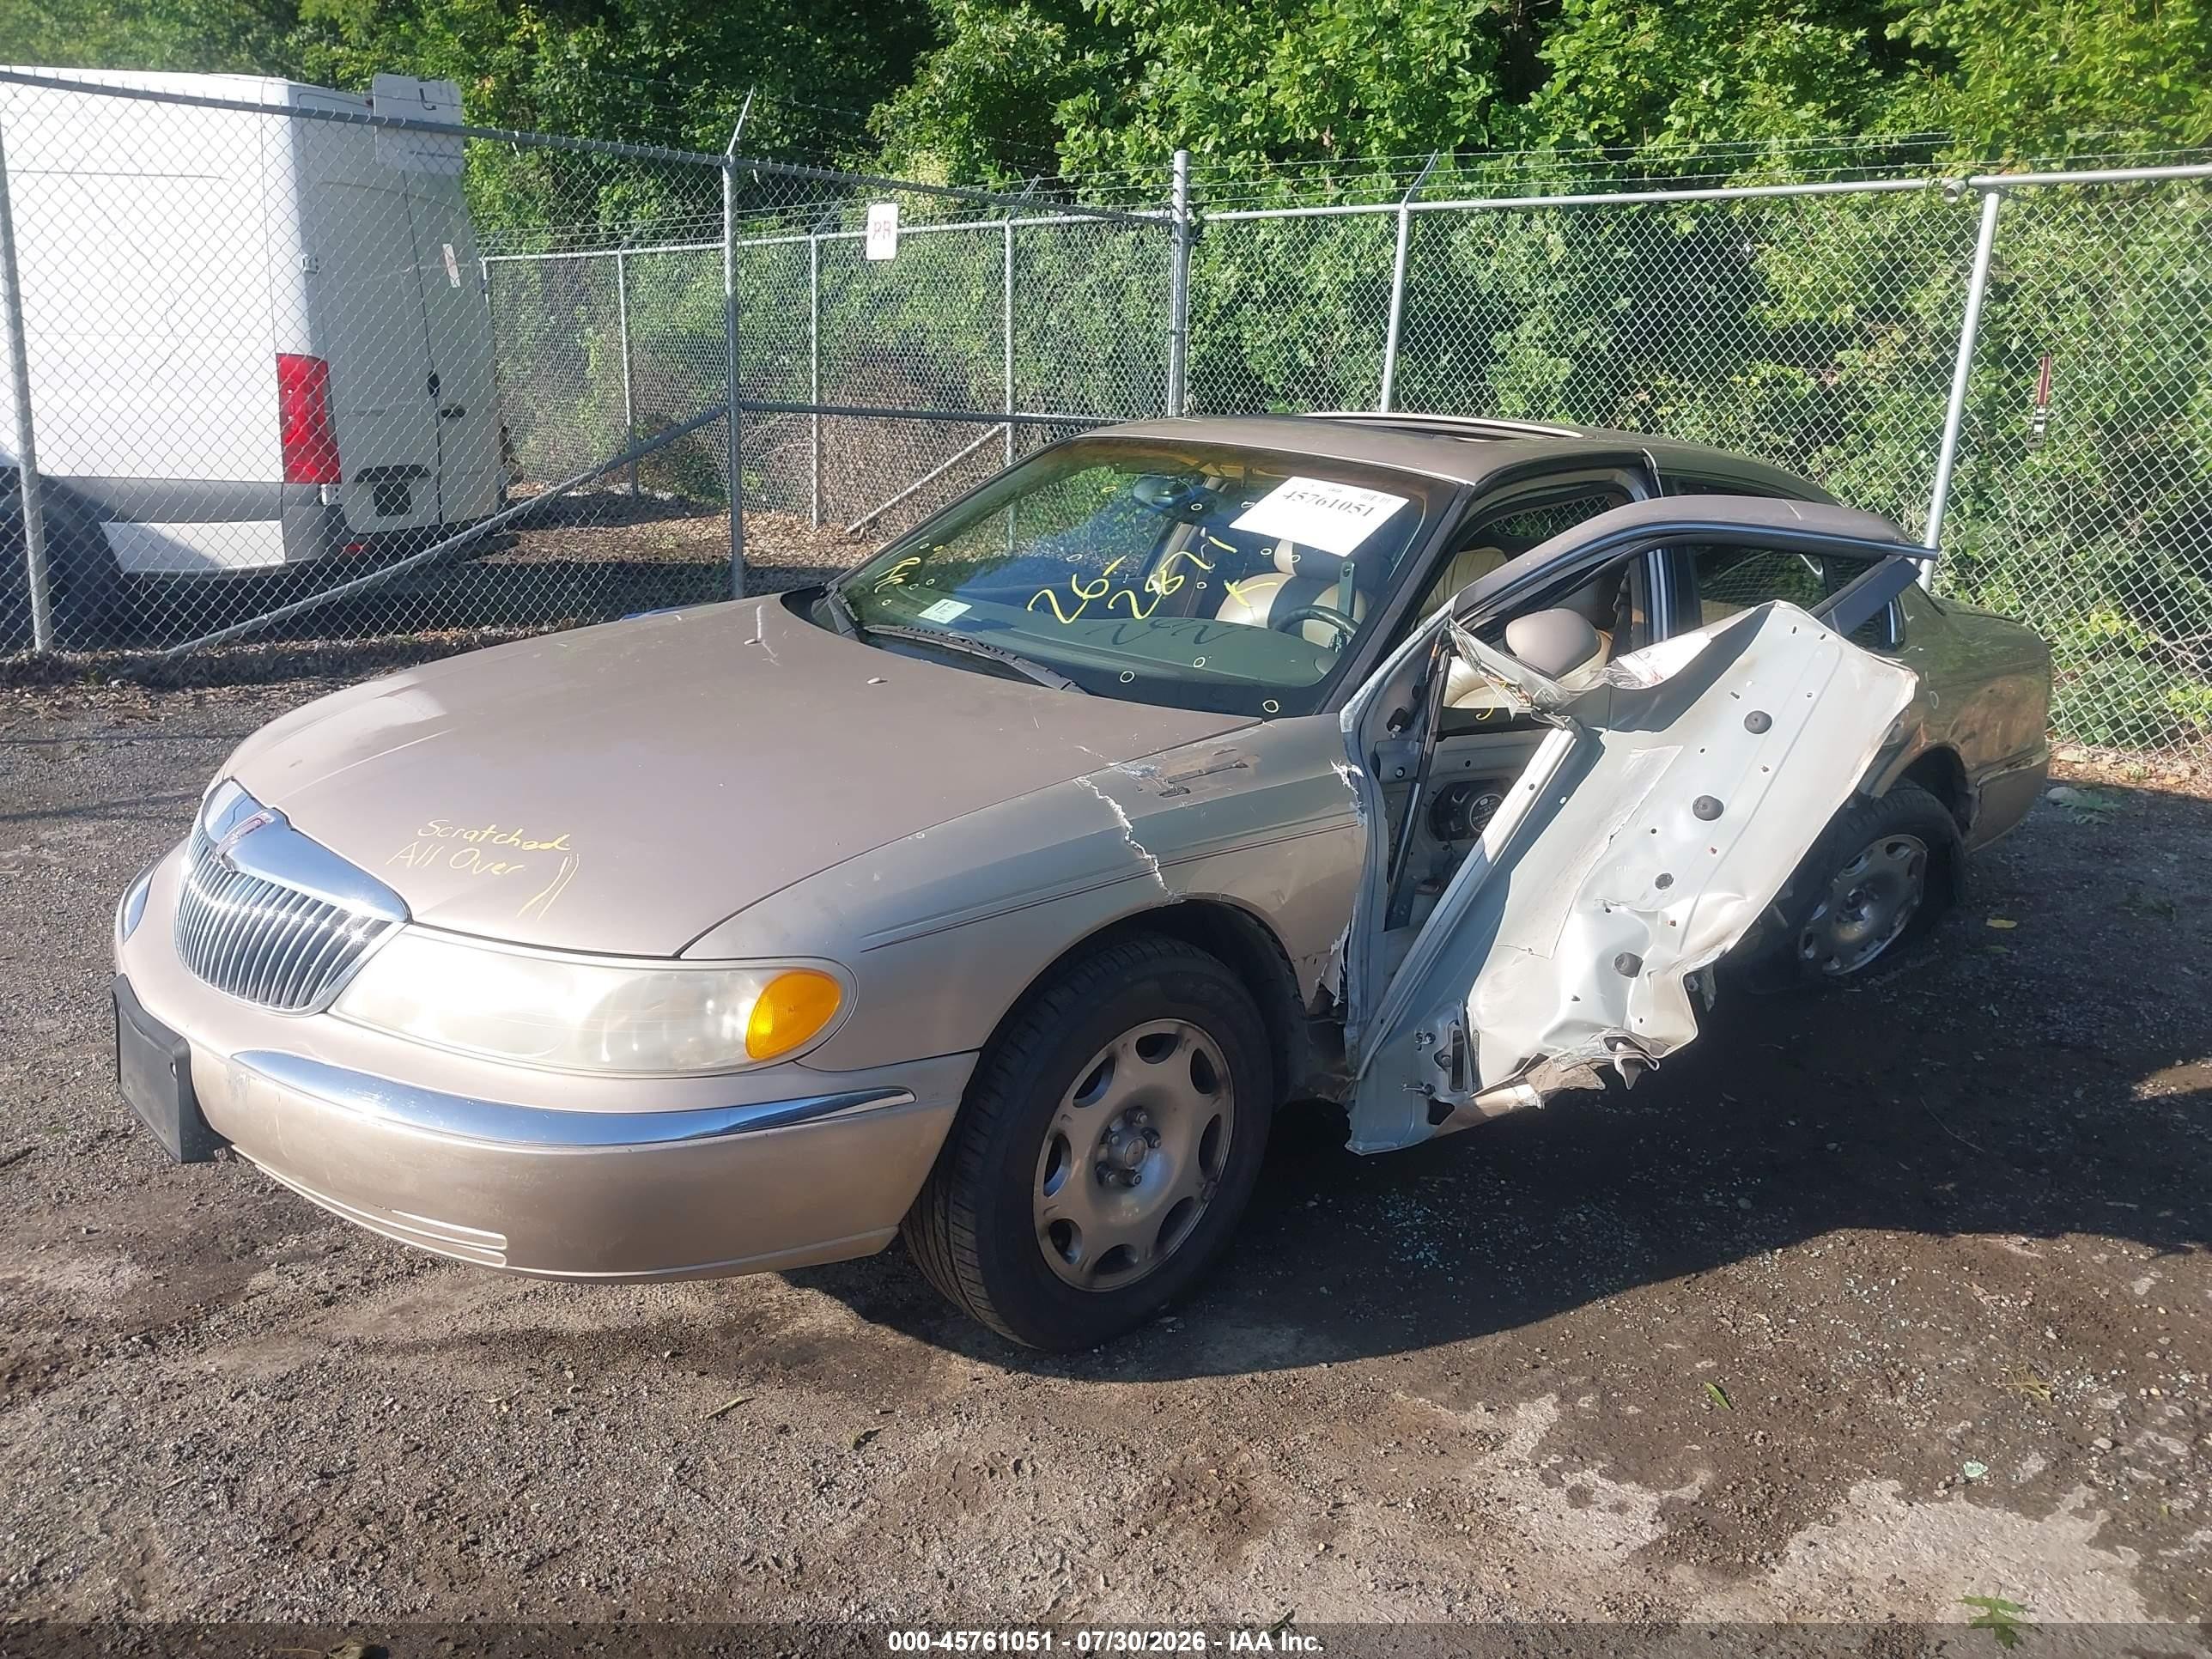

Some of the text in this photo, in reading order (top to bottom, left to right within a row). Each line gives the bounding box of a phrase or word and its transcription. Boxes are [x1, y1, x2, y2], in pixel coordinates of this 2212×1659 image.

[1283, 490, 1376, 517] 45761051
[418, 819, 571, 851] Scratched
[386, 841, 526, 875] All Over
